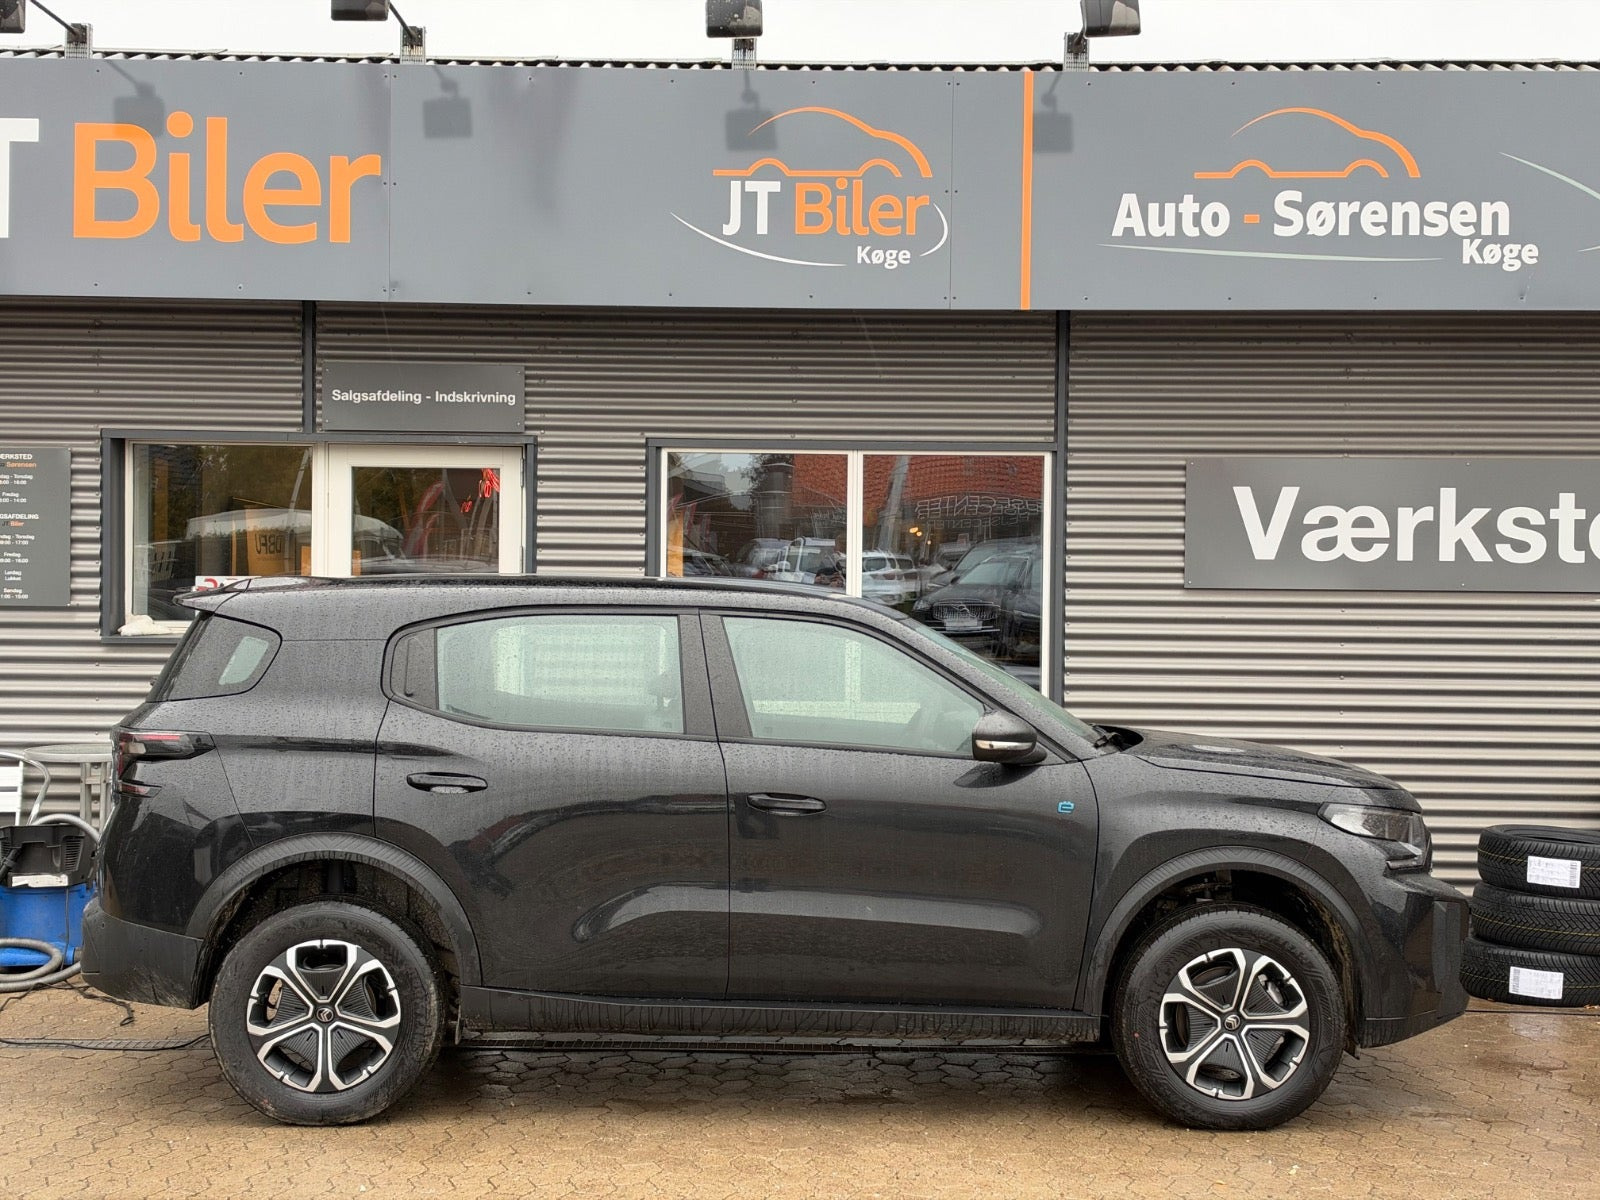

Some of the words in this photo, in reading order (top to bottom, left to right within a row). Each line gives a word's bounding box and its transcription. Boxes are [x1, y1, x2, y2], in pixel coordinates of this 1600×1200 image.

[73, 112, 381, 244] Biler
[722, 180, 781, 236] JT
[794, 177, 930, 236] Biler
[1111, 192, 1231, 238] Auto
[1272, 189, 1511, 238] Sørensen
[856, 245, 911, 270] Køge
[1462, 238, 1539, 272] Køge
[331, 388, 422, 405] Salgsafdeling
[435, 390, 516, 406] Indskrivning
[1232, 485, 1600, 564] Værkst
